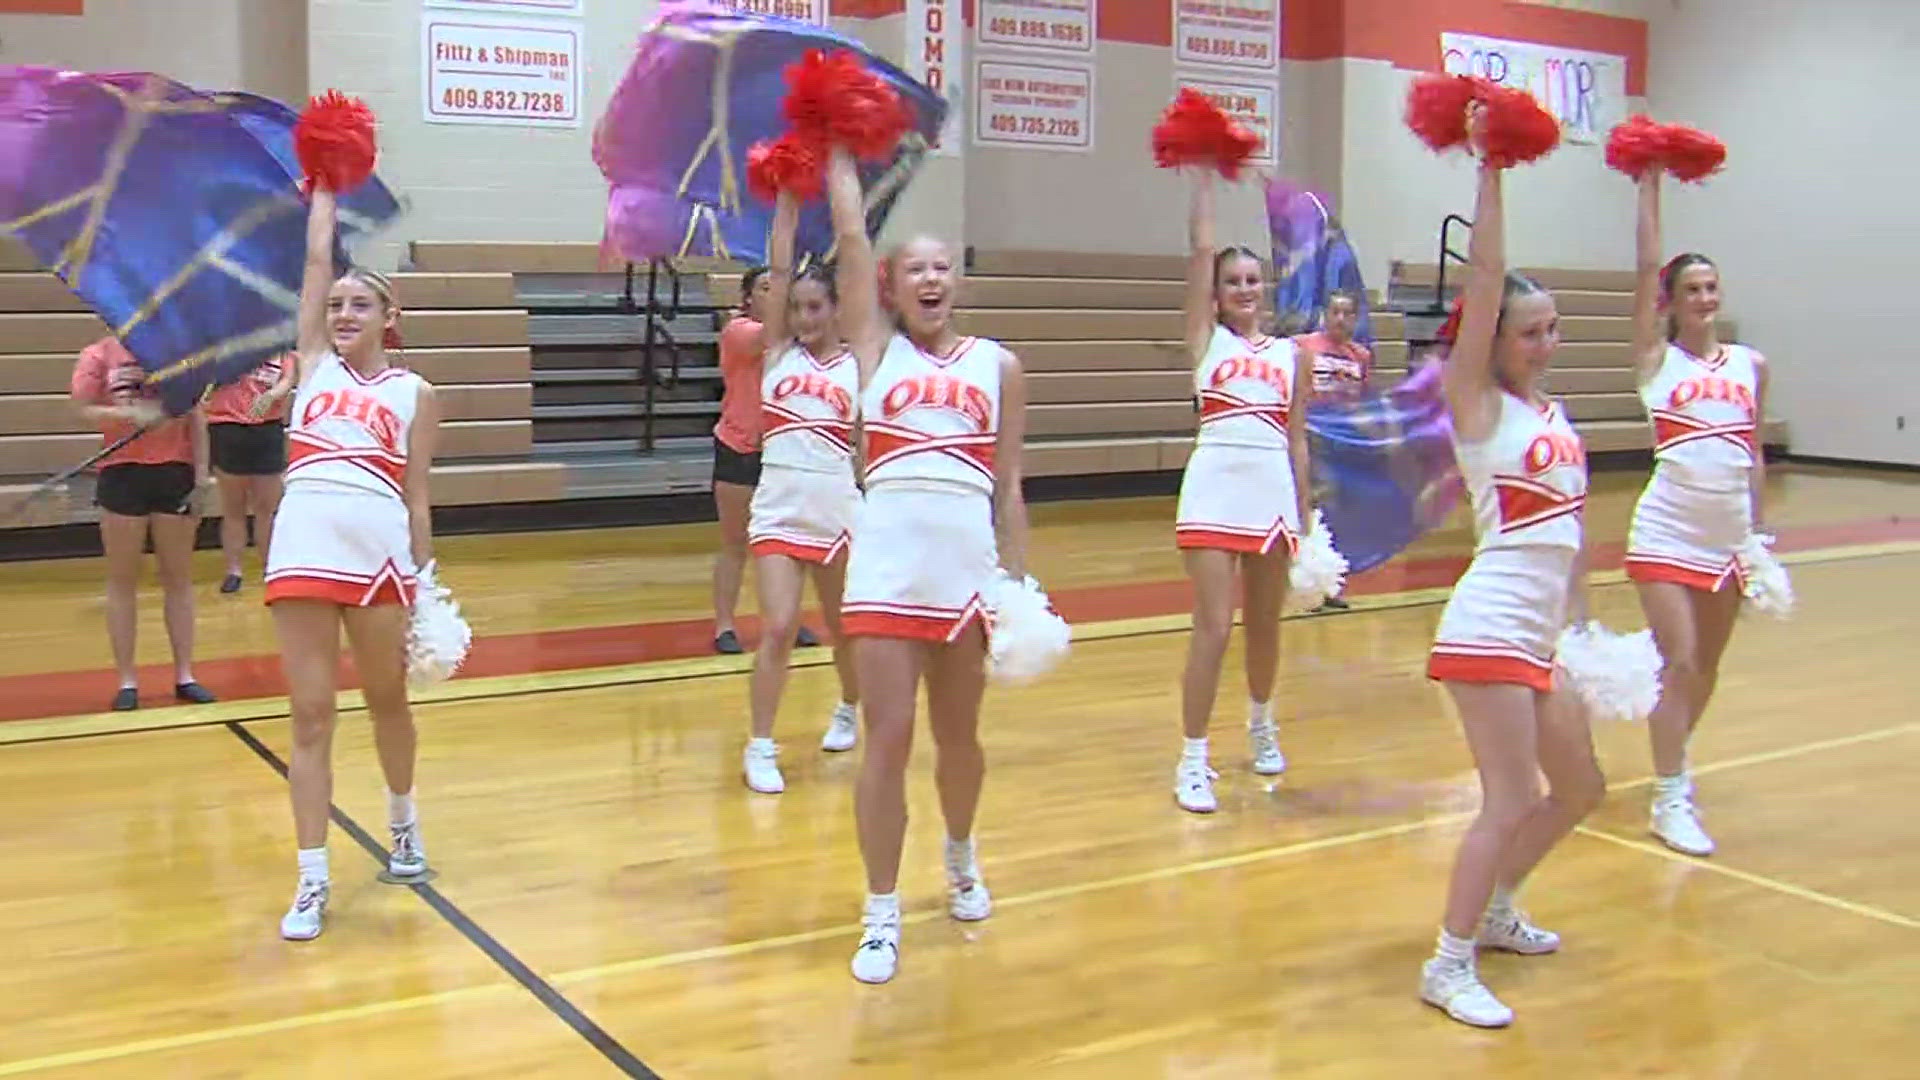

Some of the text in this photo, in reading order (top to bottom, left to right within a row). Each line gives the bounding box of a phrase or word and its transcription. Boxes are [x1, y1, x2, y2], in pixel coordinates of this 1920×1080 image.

[478, 47, 488, 63] &
[494, 46, 569, 67] Shipman
[443, 88, 564, 112] 409.832.7238
[774, 374, 849, 419] OHS
[1211, 357, 1288, 400] OHS
[303, 390, 401, 450] OHS
[883, 376, 991, 432] OHS
